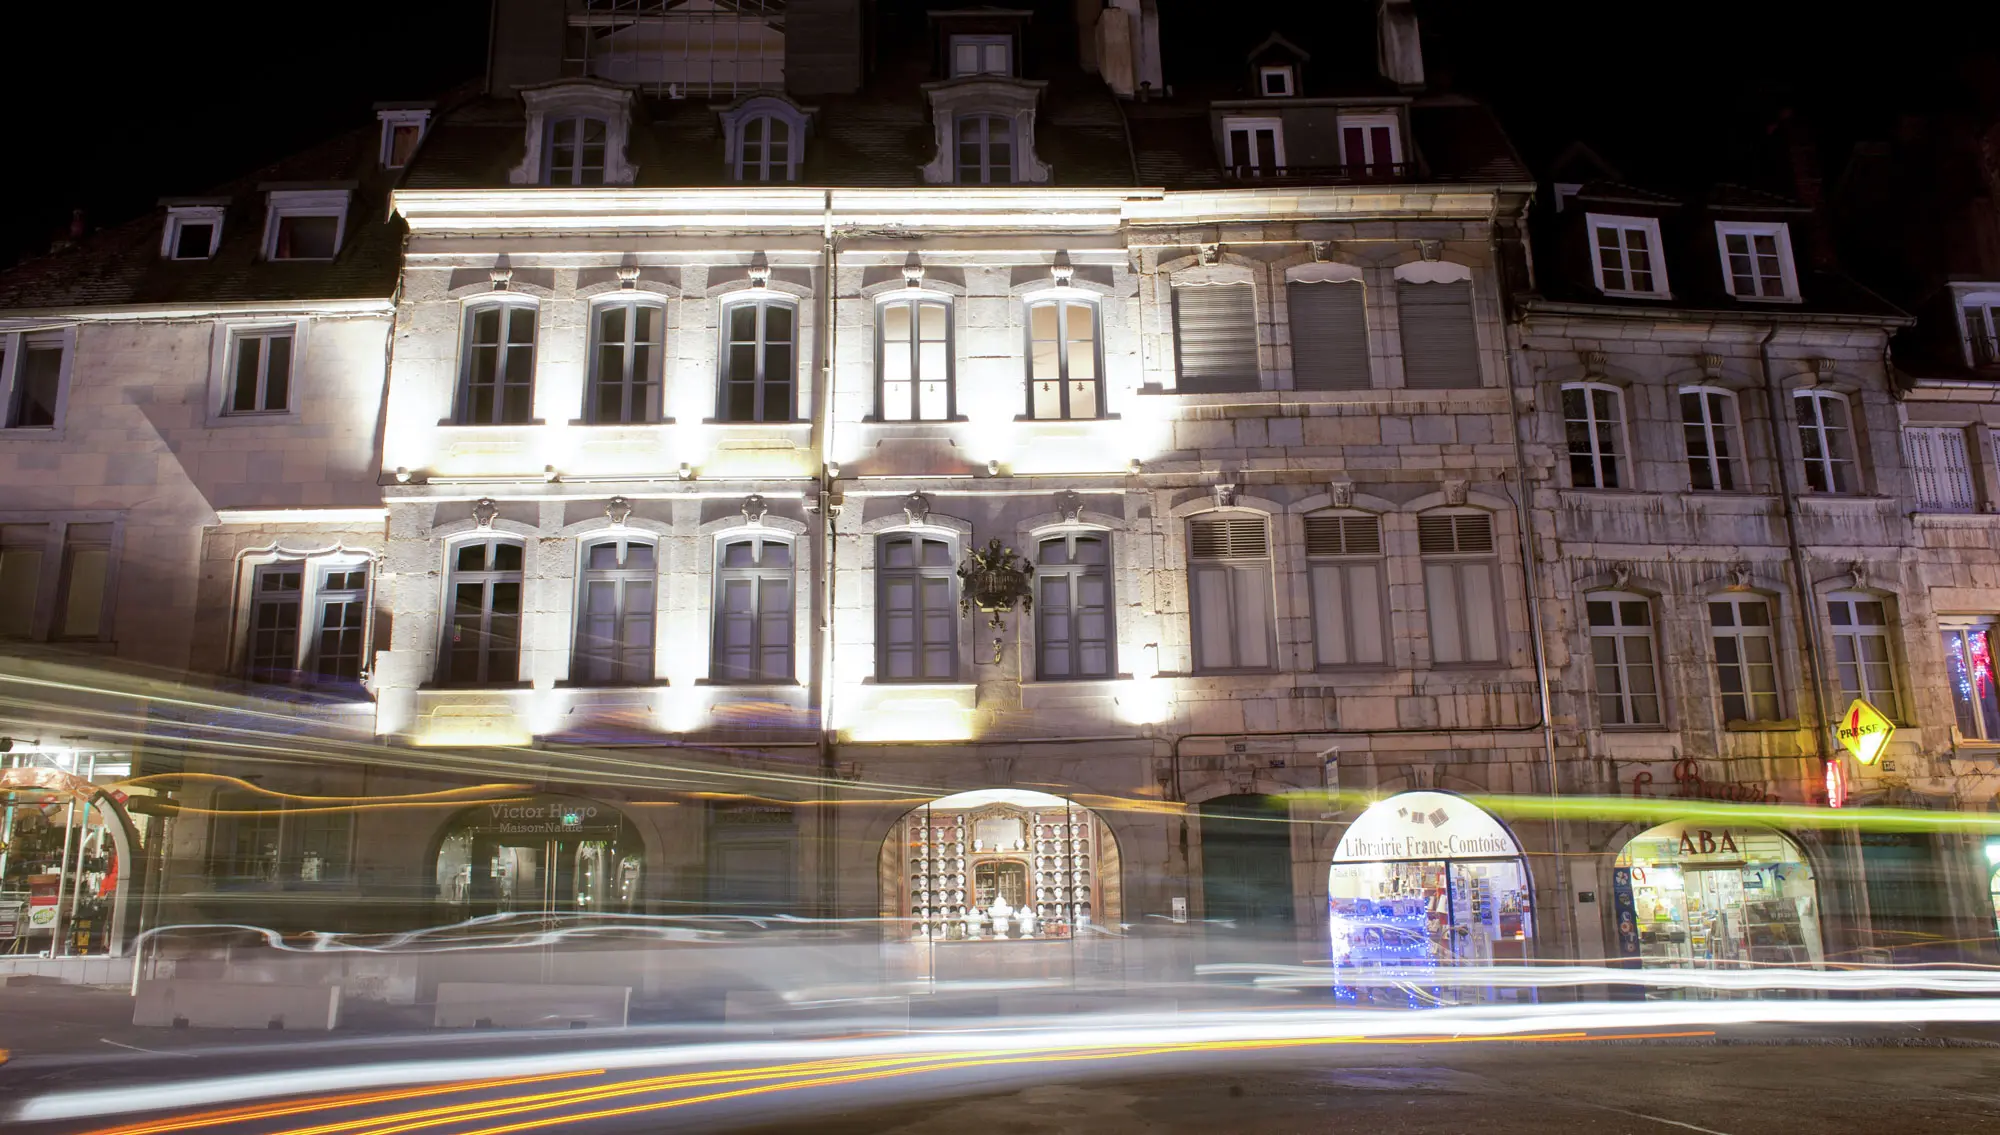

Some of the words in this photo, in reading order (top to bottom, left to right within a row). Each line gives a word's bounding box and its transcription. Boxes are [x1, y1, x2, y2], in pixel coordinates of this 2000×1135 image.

[1826, 762, 1837, 808] TABAC
[489, 804, 545, 819] Victor
[548, 803, 598, 822] Hugo
[499, 822, 541, 833] Maison
[1345, 837, 1402, 857] Librairie
[1406, 835, 1507, 855] Franc-Comtoise
[1677, 829, 1739, 855] ABA
